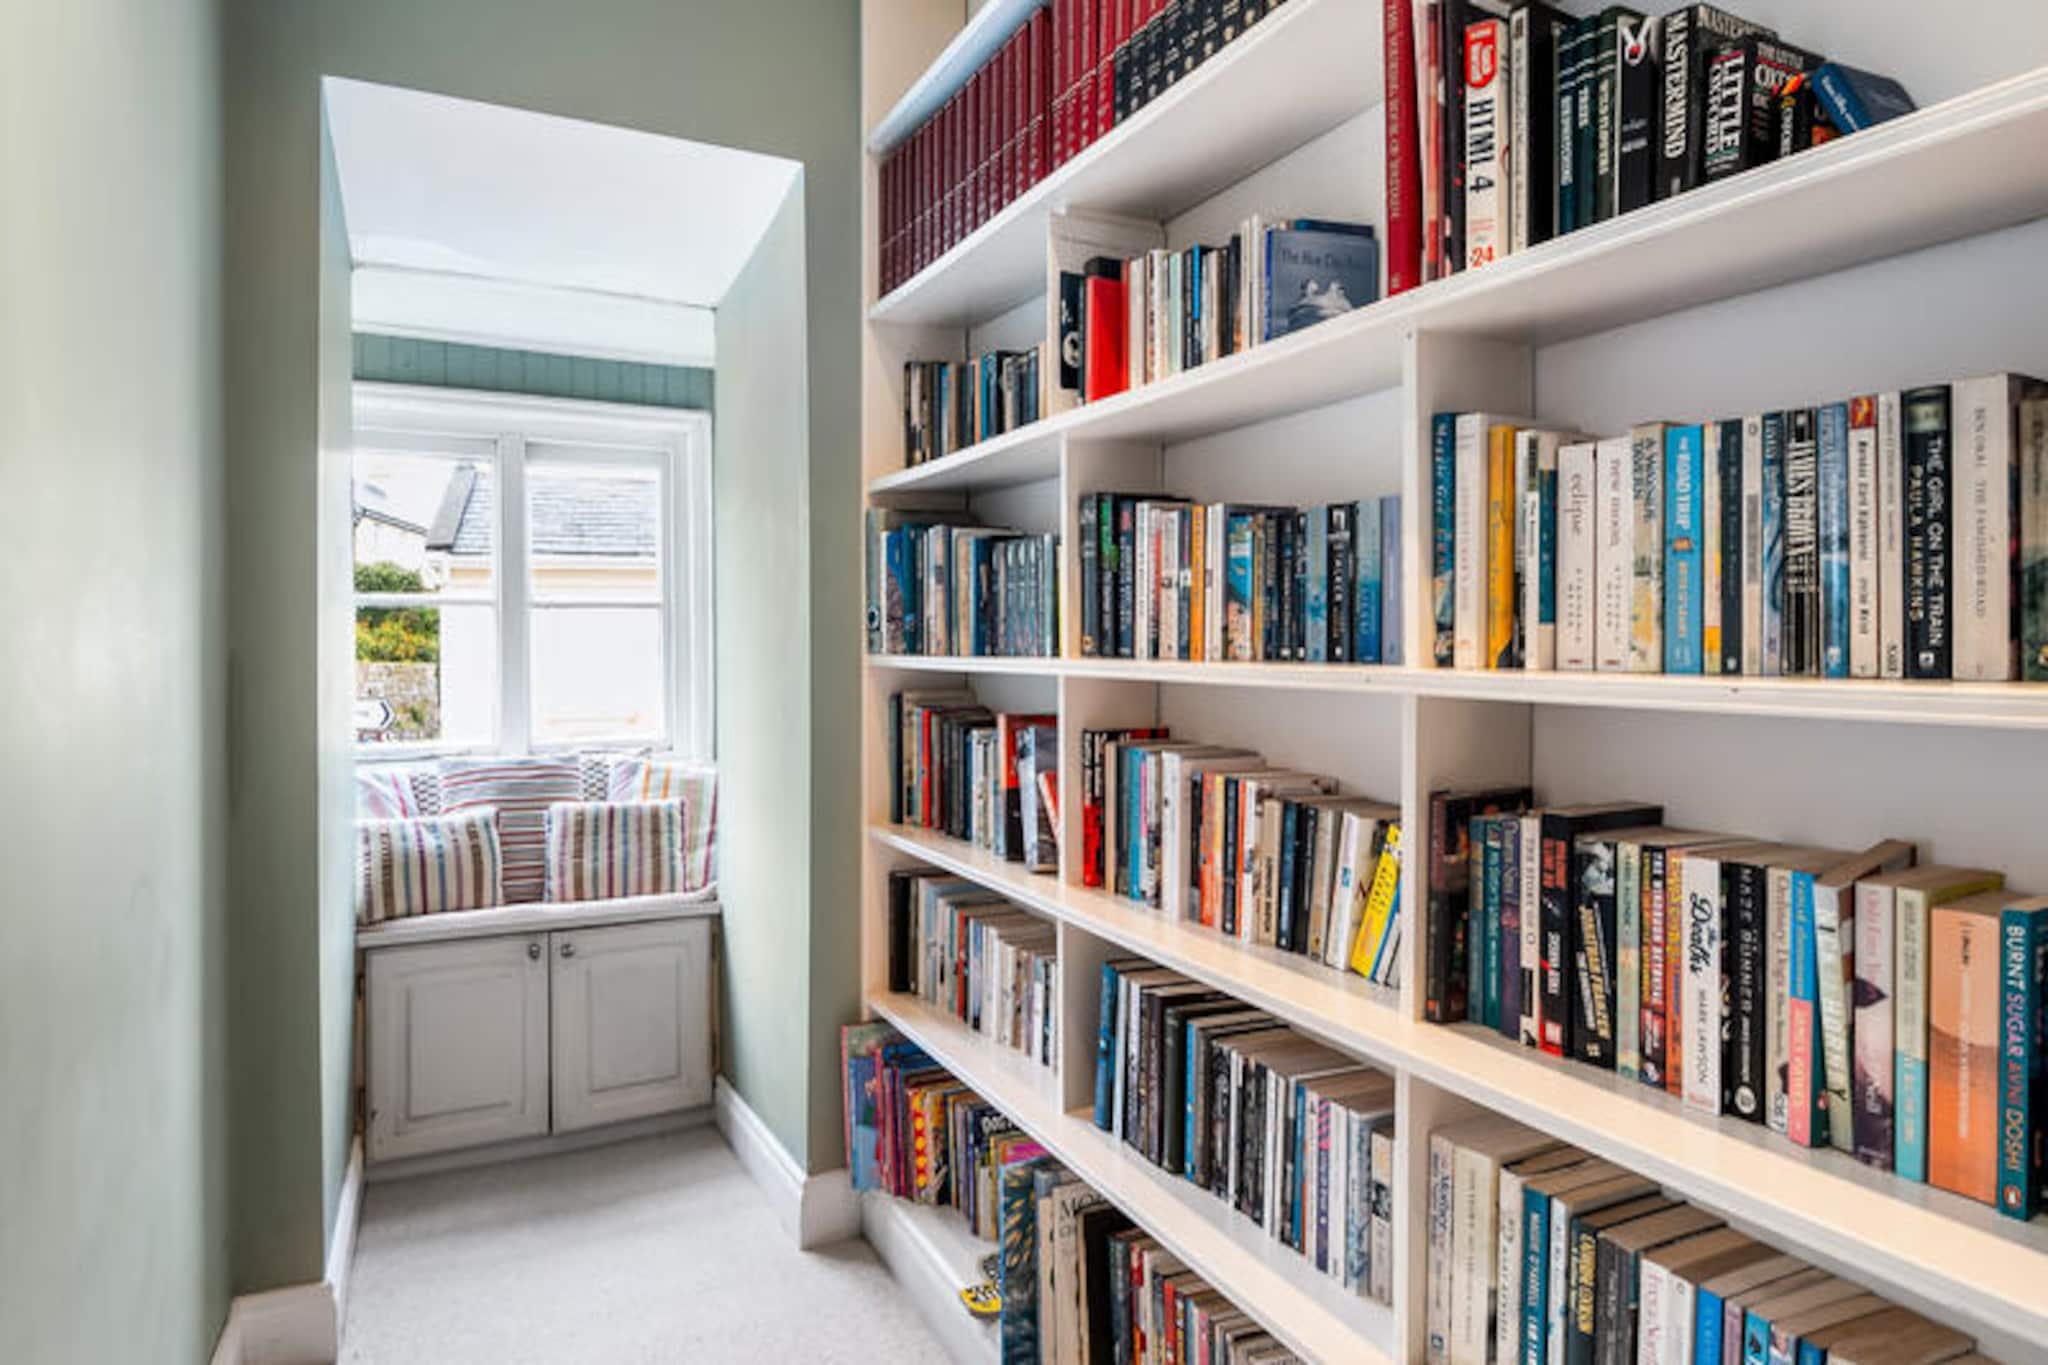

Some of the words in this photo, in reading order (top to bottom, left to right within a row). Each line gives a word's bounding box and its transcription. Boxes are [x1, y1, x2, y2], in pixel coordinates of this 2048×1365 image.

[1664, 11, 1689, 159] MASTERMIND
[1720, 53, 1746, 151] LITTLE
[1470, 176, 1494, 193] 4
[1471, 246, 1494, 268] 24
[1974, 407, 1986, 432] BEN
[1676, 453, 1692, 493] ROAD
[1927, 436, 1943, 472] THE
[1564, 474, 1587, 536] eclipse
[1909, 464, 1924, 527] PAULA
[1927, 477, 1943, 517] GIRL
[1974, 479, 1986, 504] THE
[1676, 495, 1692, 530] TRIP
[1928, 522, 1943, 550] ON
[1909, 535, 1924, 622] HAWKINS
[1928, 553, 1943, 588] THE
[1974, 578, 1987, 619] ROAD
[1928, 593, 1944, 647] TRAIN
[1525, 836, 1536, 865] THE
[1651, 851, 1663, 876] THE
[1525, 867, 1536, 908] STORY
[1739, 867, 1752, 923] MAZE
[1688, 892, 1713, 977] Deaths
[1738, 929, 1751, 1013] RUNNER
[2005, 925, 2026, 988] BURNT
[1697, 989, 1707, 1025] MARK
[2005, 991, 2026, 1057] SUGAR
[1697, 1028, 1707, 1084] LAWSON
[2005, 1059, 2025, 1105] AVNI
[2005, 1108, 2023, 1171] DOSHI
